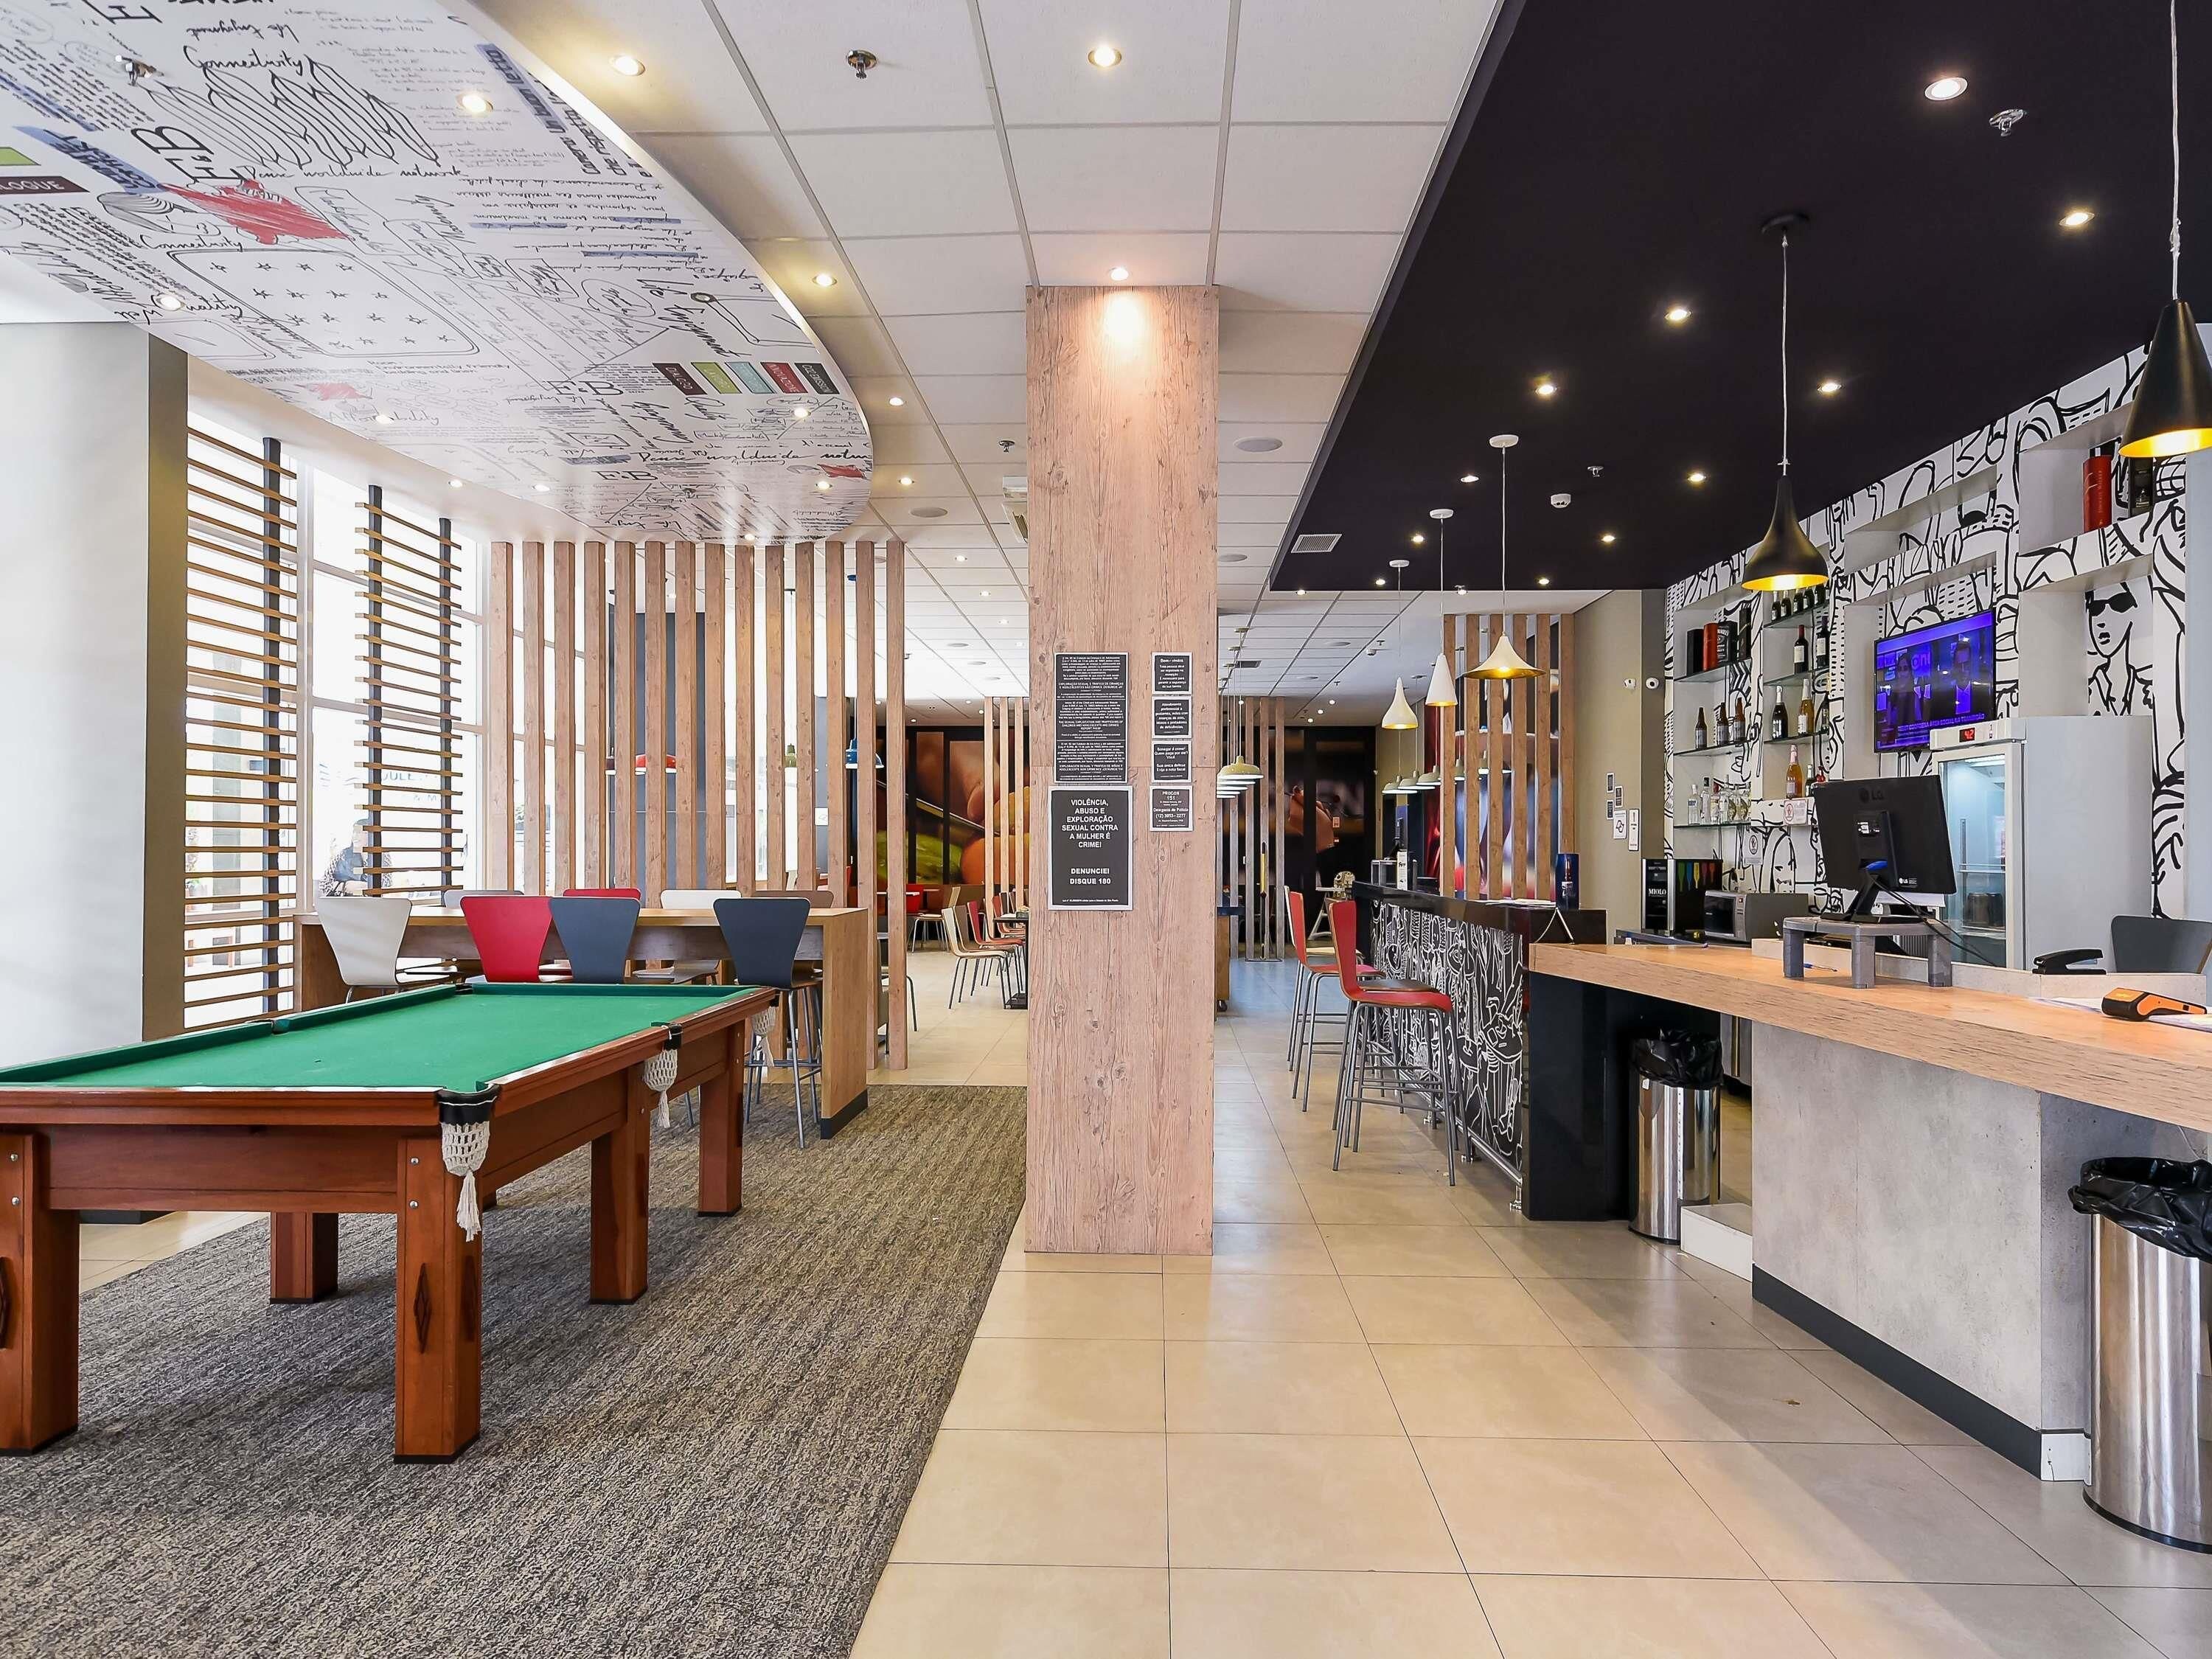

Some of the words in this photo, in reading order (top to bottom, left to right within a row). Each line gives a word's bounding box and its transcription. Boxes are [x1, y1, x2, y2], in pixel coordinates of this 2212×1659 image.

[184, 46, 303, 76] Connectivity
[1071, 798, 1109, 807] VIOLÊNCIA,
[1066, 815, 1113, 824] EXPLORAÇÃO
[1106, 832, 1110, 840] É
